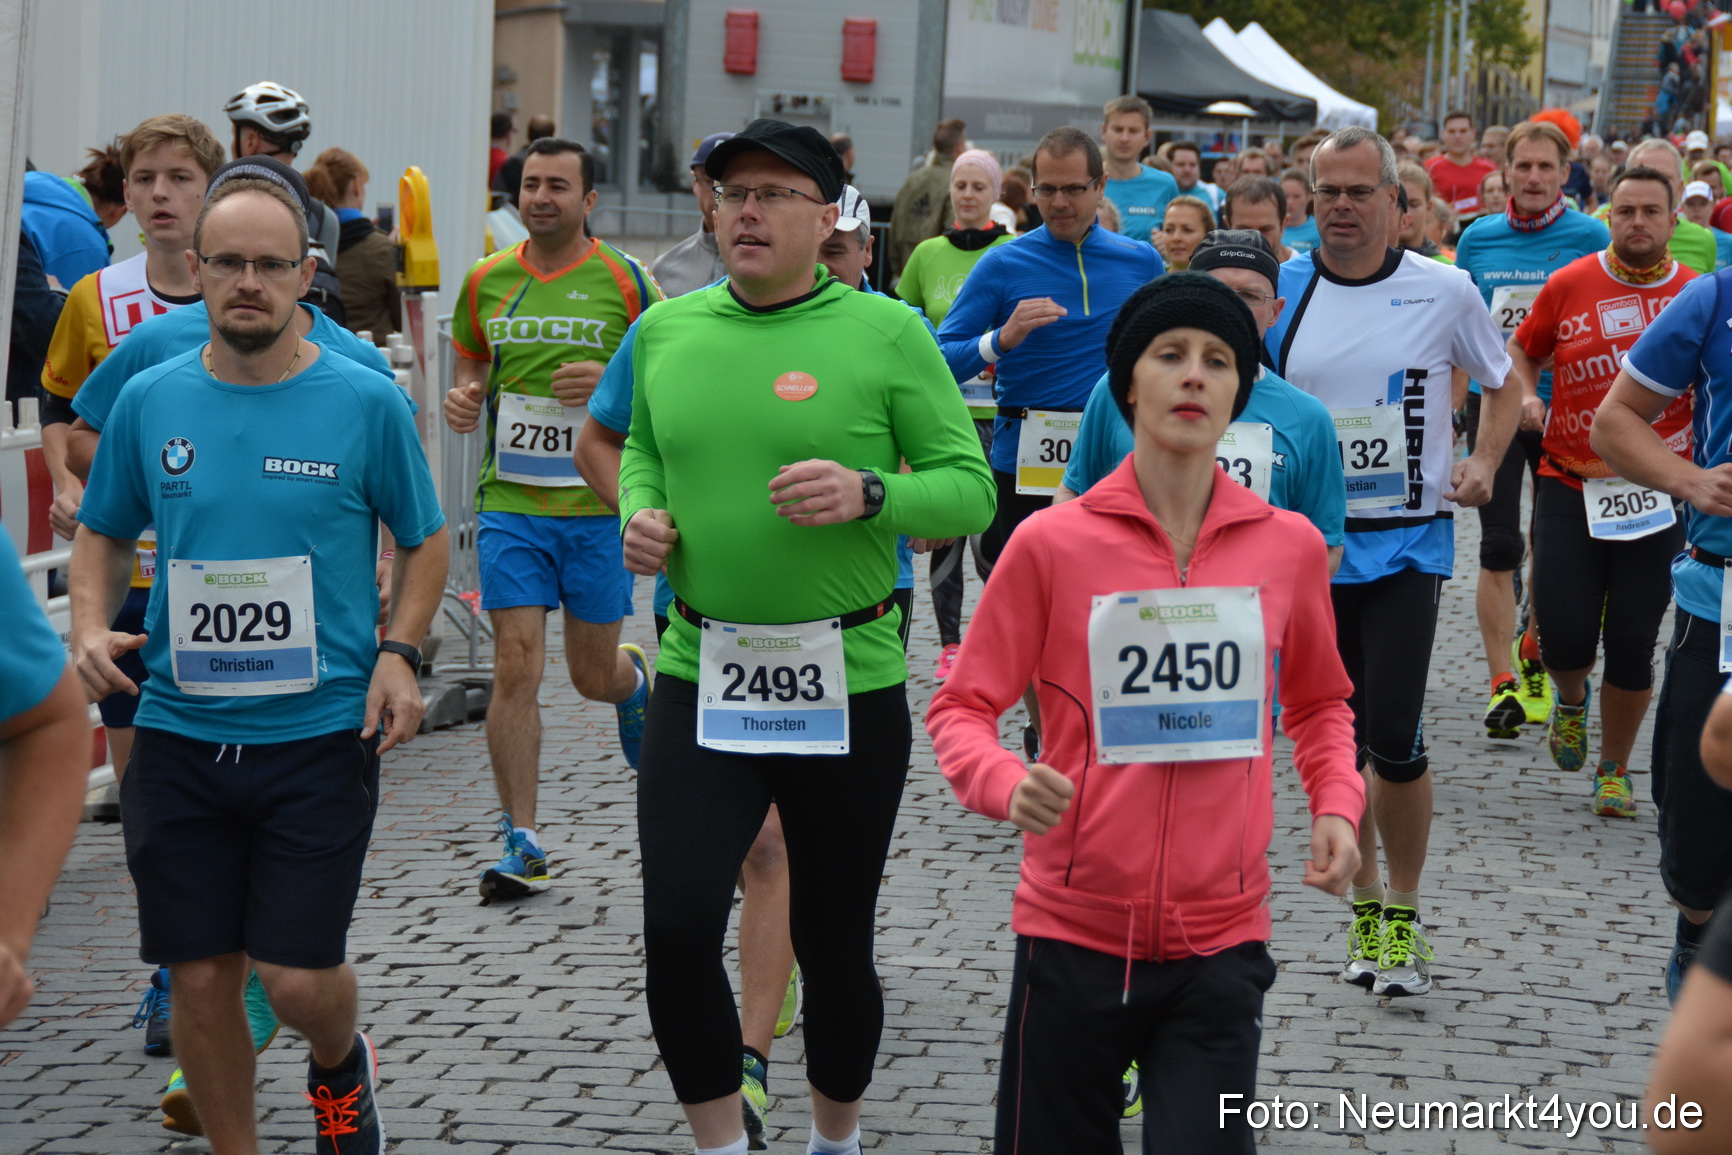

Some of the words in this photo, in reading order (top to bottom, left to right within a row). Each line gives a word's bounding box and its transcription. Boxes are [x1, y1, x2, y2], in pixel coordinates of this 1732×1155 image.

[1220, 250, 1256, 260] GripGrab
[1483, 269, 1556, 281] www.hasit.
[1600, 297, 1638, 312] raumbox
[487, 316, 607, 348] BOCK
[1333, 417, 1372, 428] BOCK
[509, 422, 573, 452] 2781
[1403, 368, 1429, 510] HUBER
[164, 438, 193, 452] BMW
[263, 456, 341, 480] BOCK
[262, 473, 286, 481] inspired
[160, 481, 192, 491] PARTL
[161, 491, 192, 499] Neumarkt
[1598, 490, 1658, 519] 2505
[1615, 519, 1650, 532] Andreas
[217, 572, 268, 585] BOCK
[1157, 604, 1218, 619] BOCK
[190, 600, 291, 643] 2029
[178, 637, 184, 645] D
[751, 637, 801, 648] BOCK
[210, 657, 274, 673] Christian
[1118, 640, 1241, 695] 2450
[722, 662, 825, 702] 2493
[1103, 690, 1109, 699] D
[741, 716, 806, 731] Thorsten
[1158, 712, 1213, 731] Nicole
